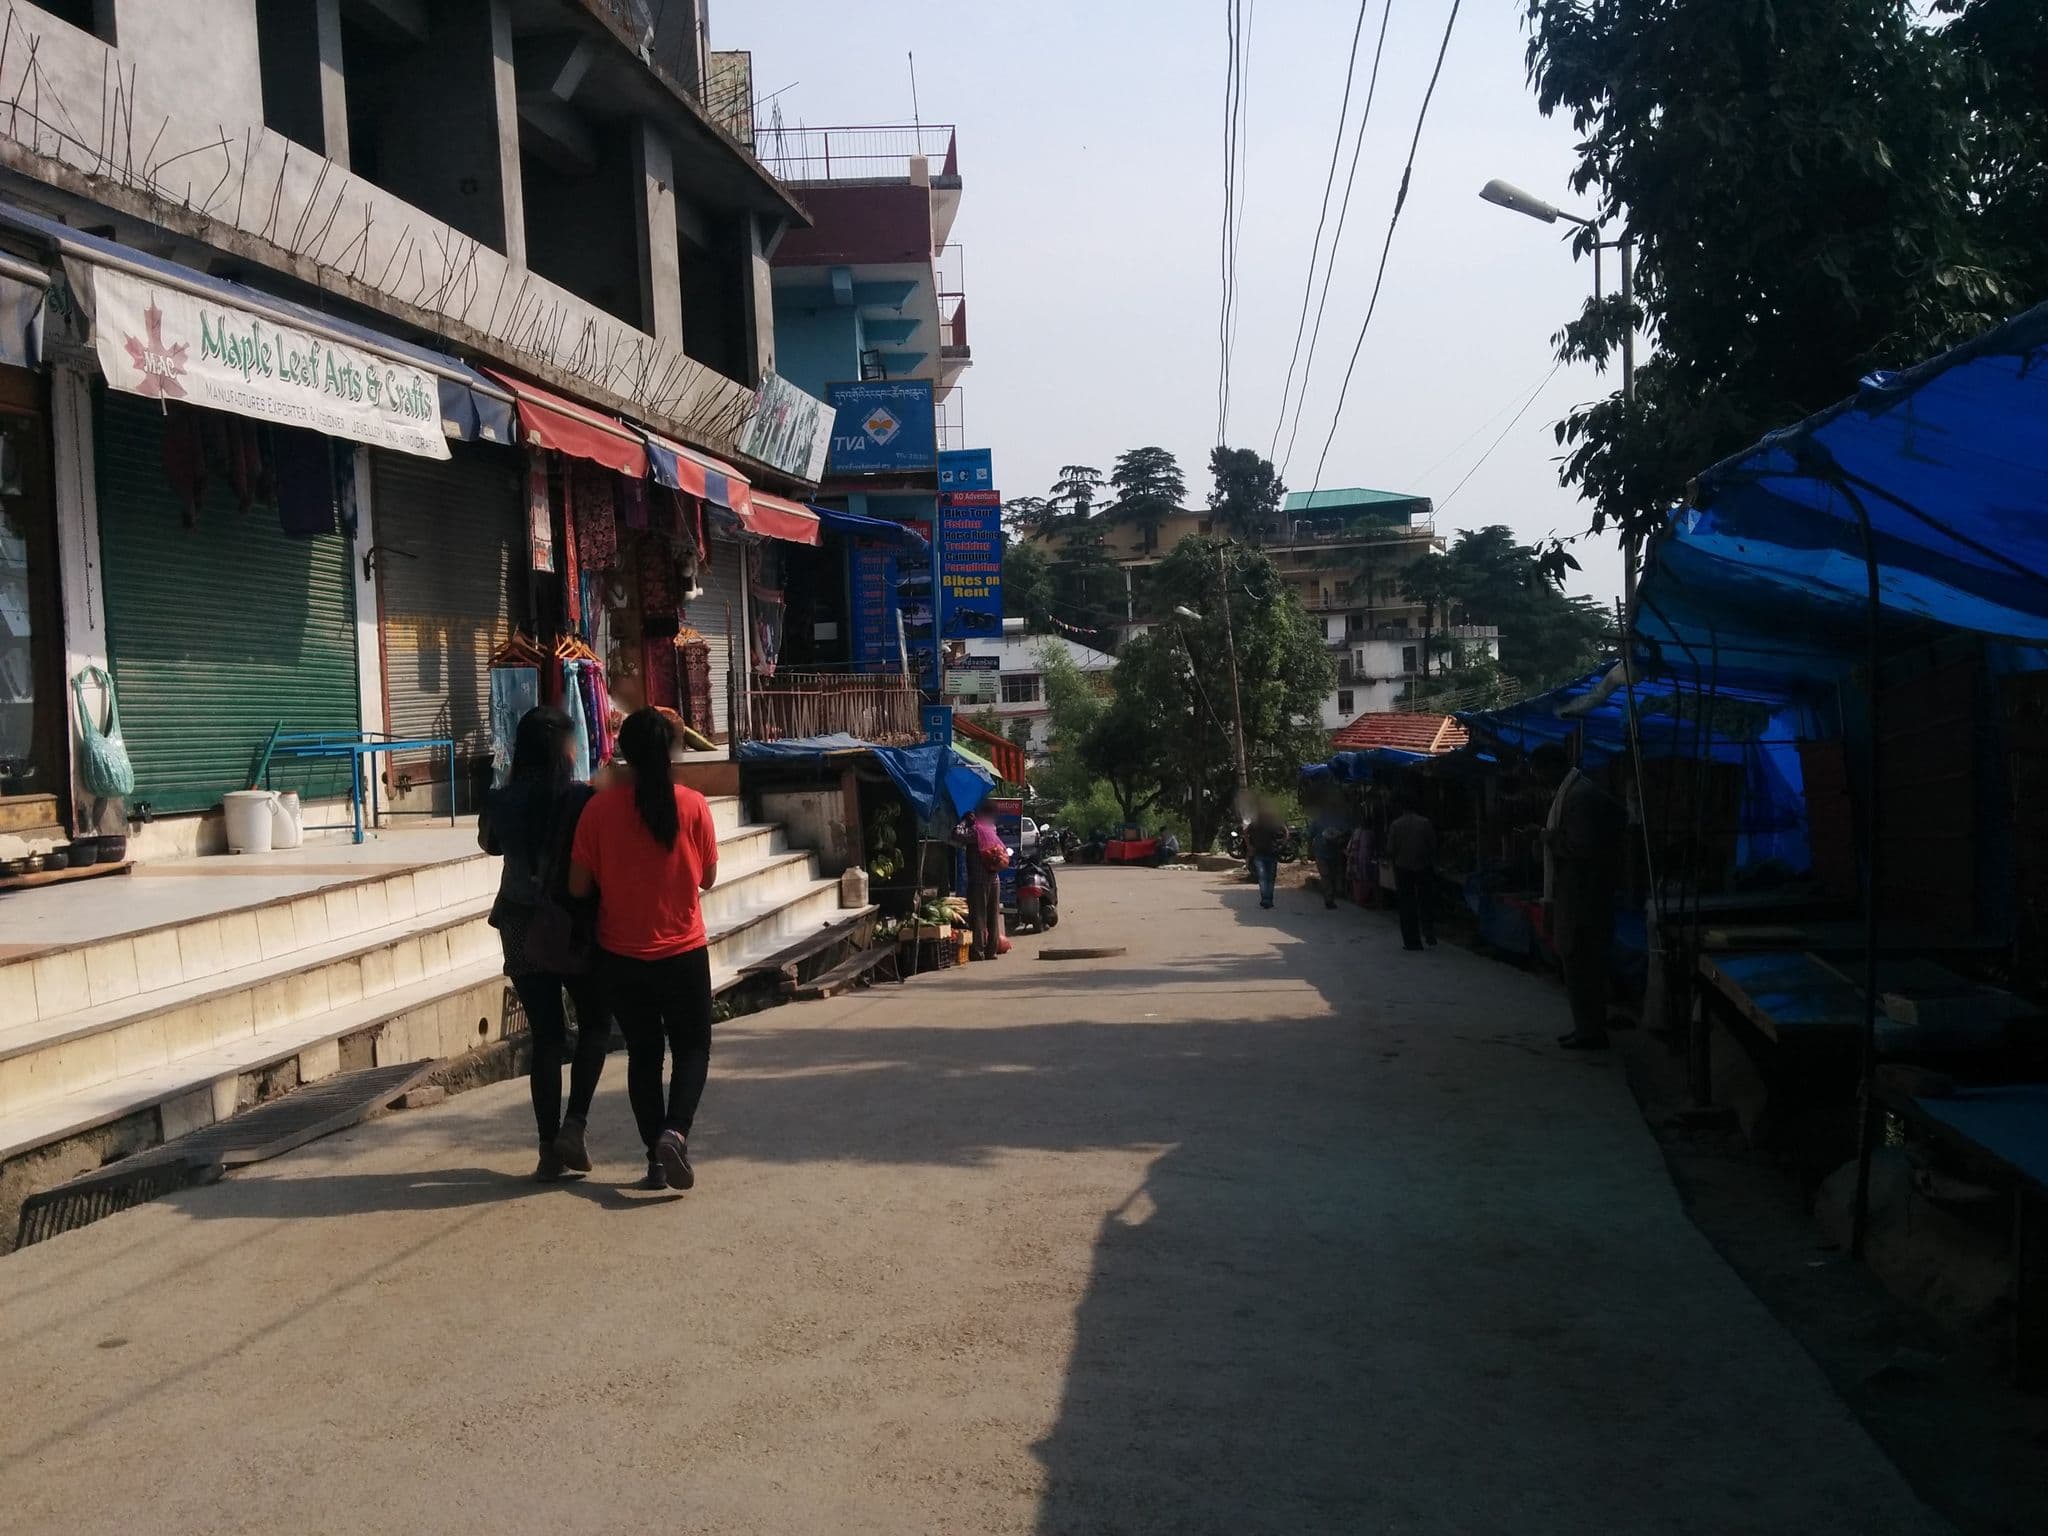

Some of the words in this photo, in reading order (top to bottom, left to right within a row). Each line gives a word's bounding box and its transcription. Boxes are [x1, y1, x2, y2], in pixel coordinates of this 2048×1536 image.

[200, 308, 273, 384] Maple
[276, 334, 319, 387] Leaf
[324, 352, 363, 402] Arts
[365, 367, 382, 407] &
[385, 372, 433, 421] Crafts
[834, 436, 866, 452] TVA
[969, 507, 993, 518] Tour
[943, 575, 983, 587] Bikes
[985, 575, 1001, 586] on
[953, 587, 990, 598] Rent
